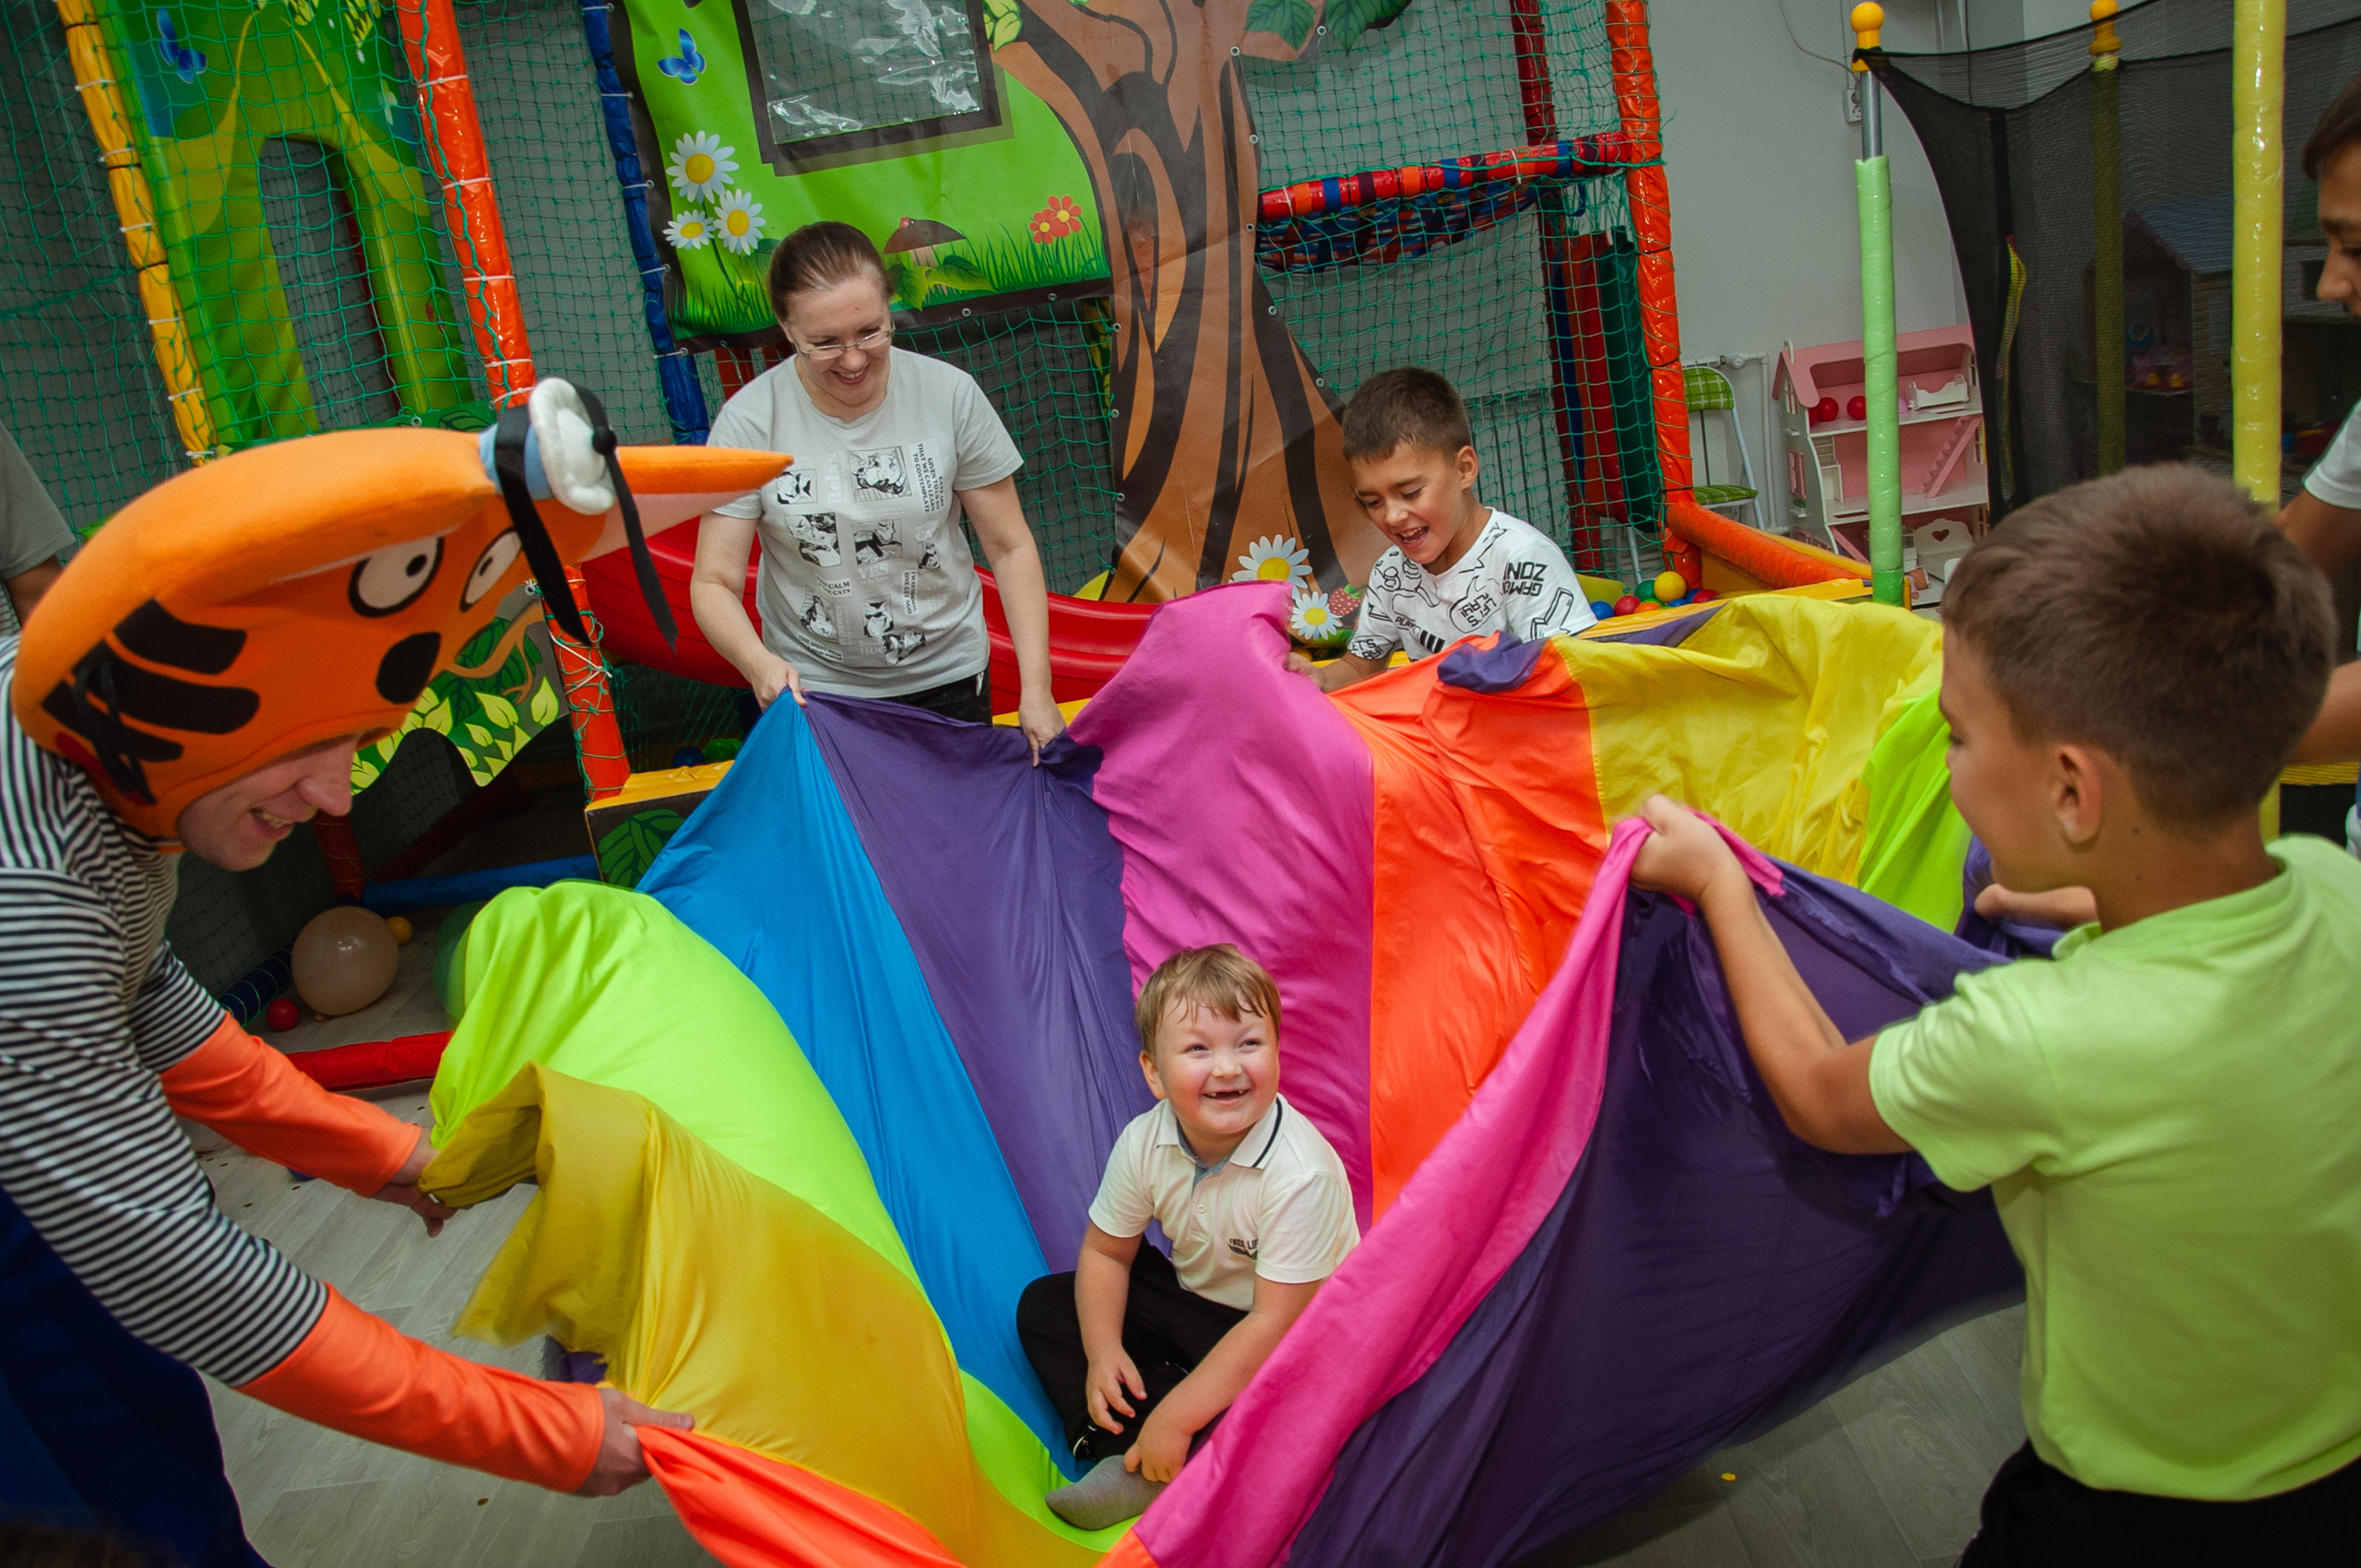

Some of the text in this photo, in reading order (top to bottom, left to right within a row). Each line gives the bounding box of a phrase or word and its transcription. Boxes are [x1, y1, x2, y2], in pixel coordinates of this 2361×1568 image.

[913, 453, 919, 463] TO
[918, 443, 926, 461] THAT
[921, 463, 929, 474] WE
[927, 457, 936, 478] GIVEN
[933, 480, 938, 489] TO
[915, 463, 930, 514] CONTEMPLATE
[858, 564, 889, 579] YES
[828, 581, 849, 589] CALM
[1349, 638, 1376, 651] ET'S
